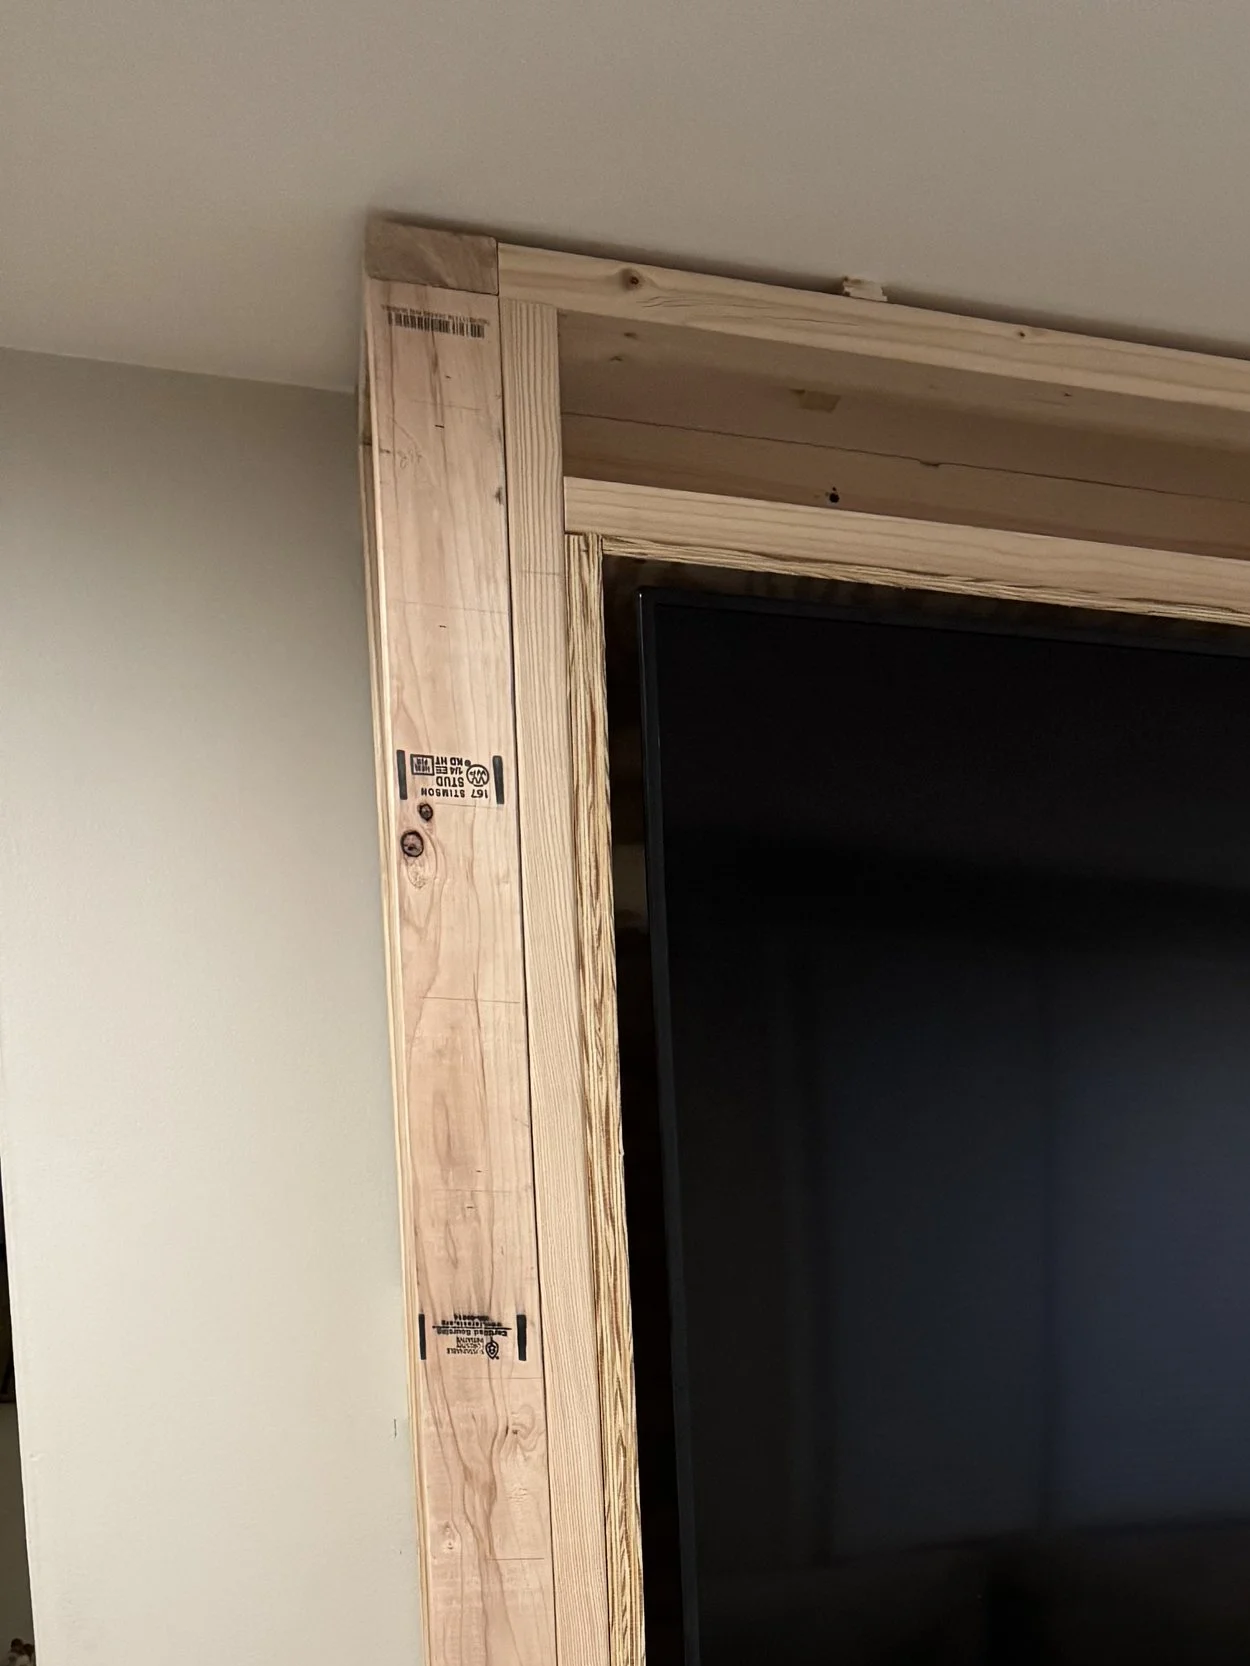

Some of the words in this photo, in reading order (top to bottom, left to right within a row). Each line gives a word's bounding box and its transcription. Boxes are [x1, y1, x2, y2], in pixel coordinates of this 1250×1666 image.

[434, 756, 448, 766] HT
[449, 757, 464, 766] KD
[435, 776, 465, 788] STUD
[420, 787, 466, 798] STIMSON
[470, 789, 489, 799] 167
